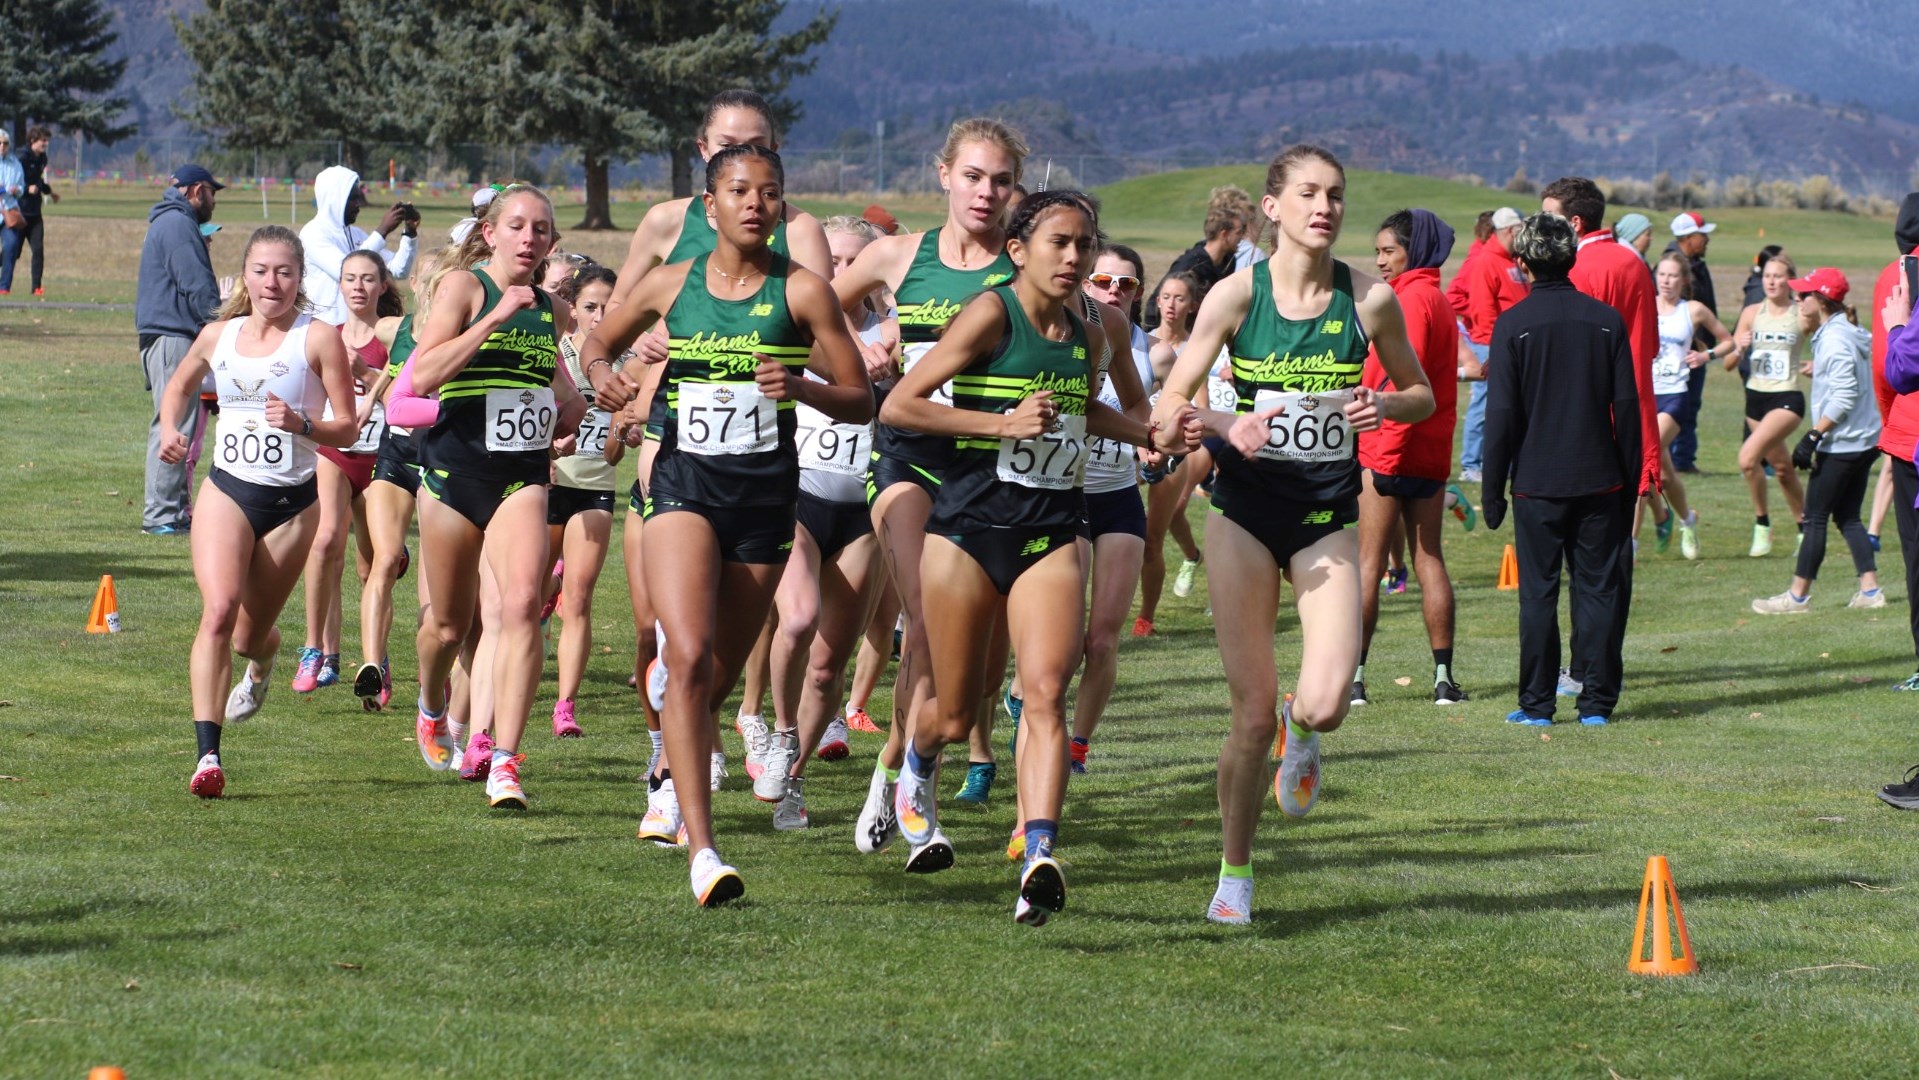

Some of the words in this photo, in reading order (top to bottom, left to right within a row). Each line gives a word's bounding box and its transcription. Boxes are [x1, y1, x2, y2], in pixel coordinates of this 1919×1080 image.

[499, 327, 554, 350] Adams
[680, 330, 761, 360] Adams
[1752, 332, 1798, 345] UCCS
[1251, 348, 1336, 382] Adams
[1753, 358, 1784, 375] 769
[1018, 370, 1088, 400] Adams
[1282, 372, 1346, 393] State
[496, 406, 552, 441] 569
[575, 424, 609, 451] 75
[688, 405, 761, 444] 571
[1266, 411, 1345, 451] 566
[223, 433, 283, 464] 808
[710, 441, 766, 452] CHAMPIONSHIP
[798, 425, 859, 465] 791
[1009, 437, 1080, 477] 572
[1262, 448, 1286, 457] RMAC
[1287, 449, 1344, 458] CHAMPIONSHIP
[811, 460, 858, 472] CHAMPIONSHIP
